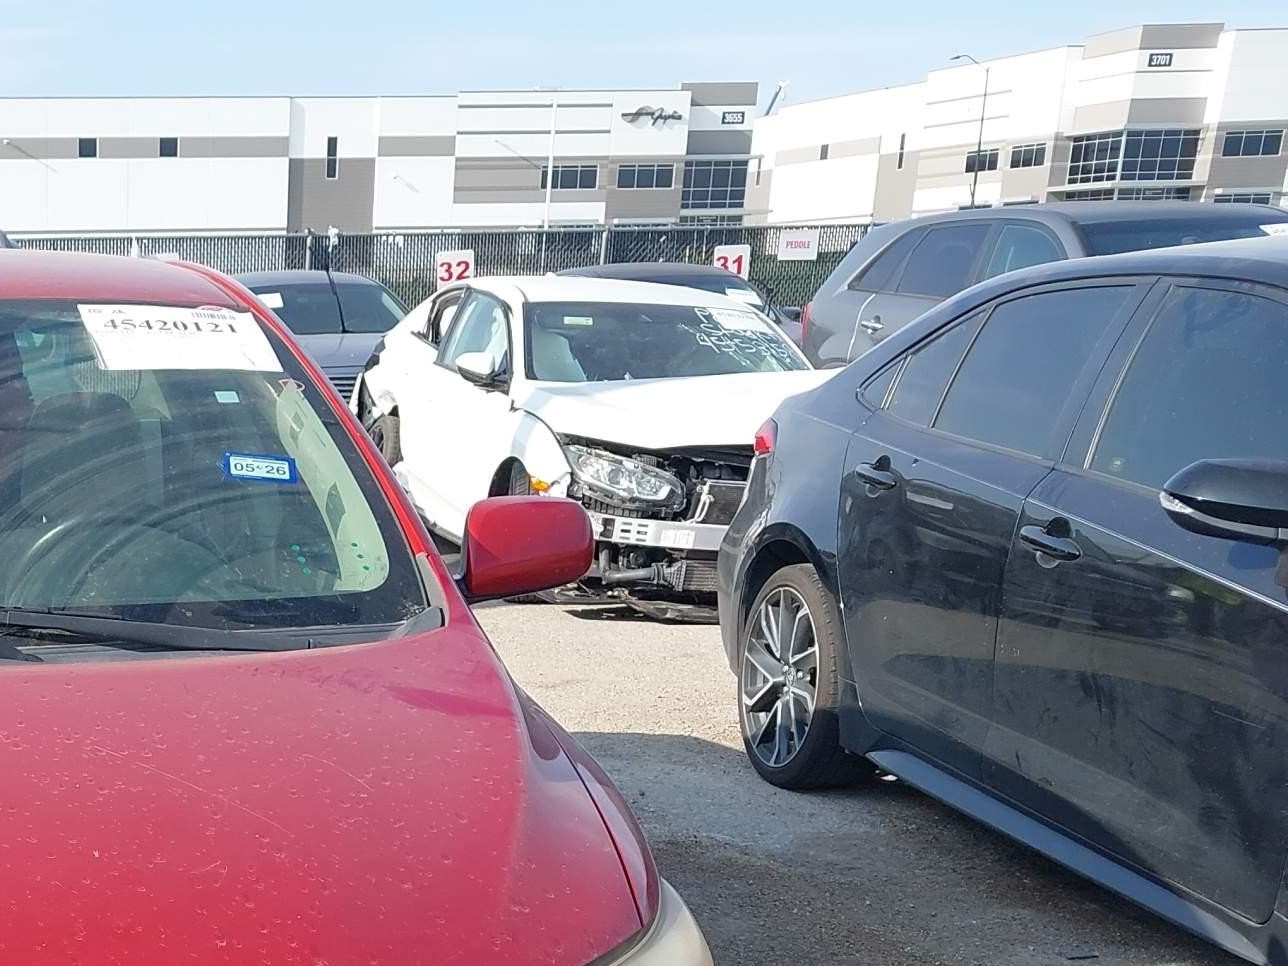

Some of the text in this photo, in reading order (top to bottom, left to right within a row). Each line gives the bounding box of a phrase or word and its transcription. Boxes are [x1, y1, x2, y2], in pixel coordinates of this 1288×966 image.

[1151, 54, 1171, 65] 3701
[439, 260, 471, 282] 32
[716, 254, 744, 274] 31
[103, 318, 238, 334] 45420121
[234, 462, 287, 476] 05 26
